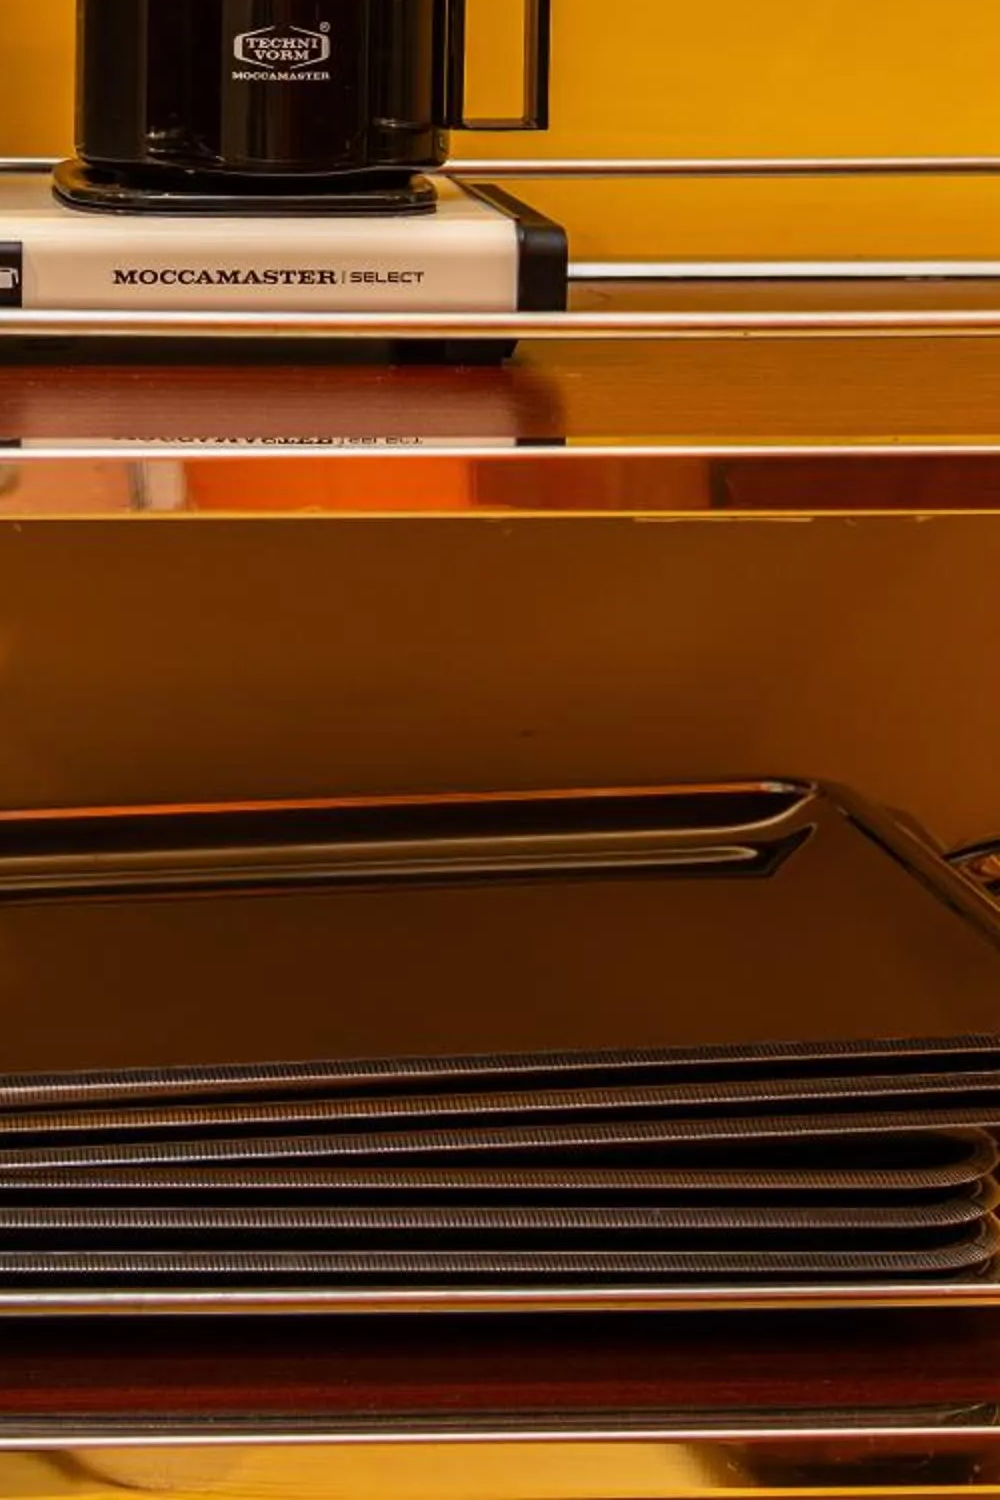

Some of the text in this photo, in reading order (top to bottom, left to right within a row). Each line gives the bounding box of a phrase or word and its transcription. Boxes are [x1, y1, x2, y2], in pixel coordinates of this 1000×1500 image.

[246, 37, 319, 49] TECHNI
[253, 49, 311, 61] VORM
[231, 71, 330, 81] MOCCAMASTER
[112, 269, 425, 285] MOCCAMASTER SELECT
